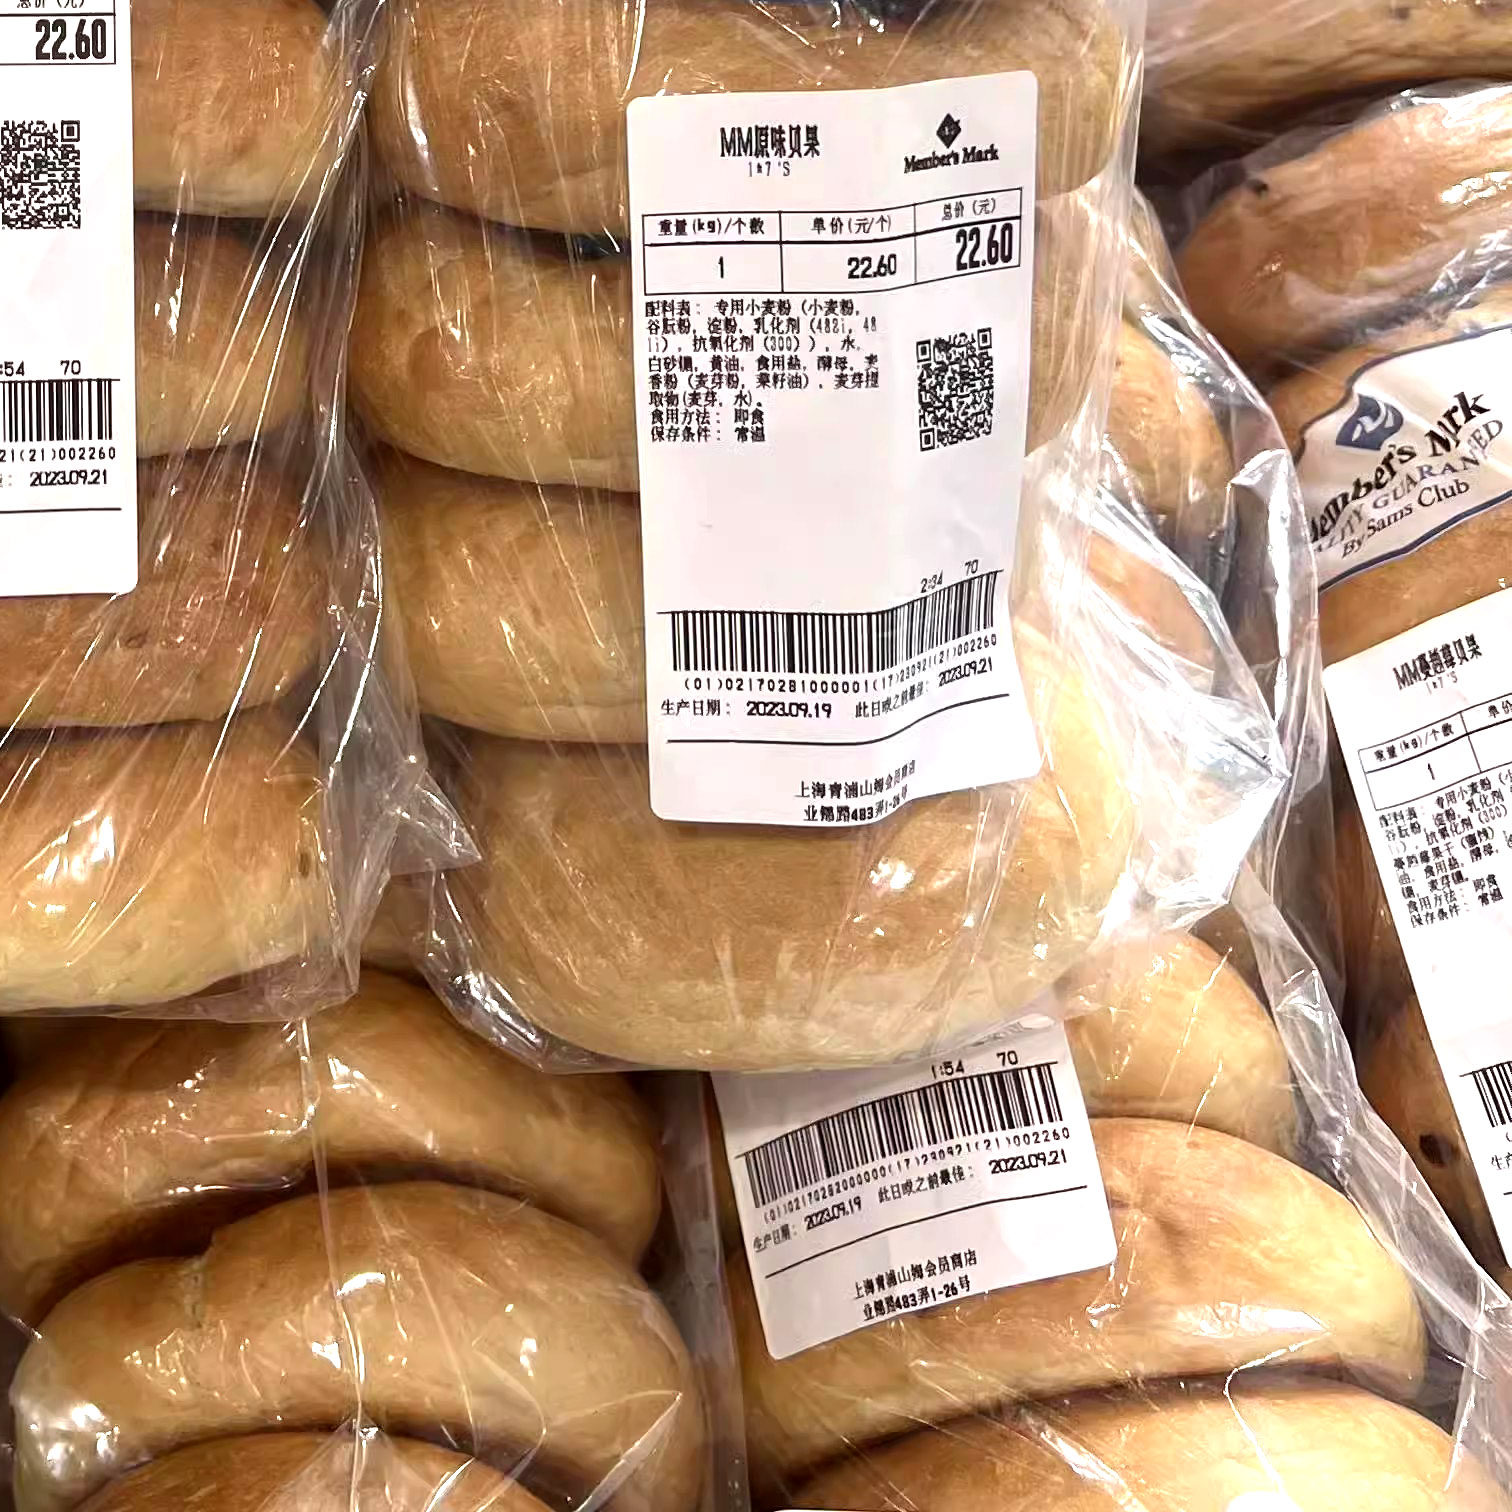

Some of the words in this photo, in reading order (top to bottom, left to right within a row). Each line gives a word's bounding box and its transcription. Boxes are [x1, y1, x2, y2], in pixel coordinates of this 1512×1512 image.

[35, 19, 107, 60] 22.60
[720, 125, 820, 158] MM原味贝果
[955, 222, 1013, 271] 22.60
[718, 256, 725, 278] 1
[847, 254, 897, 280] 22.60
[61, 360, 82, 375] 70
[30, 469, 108, 487] 2023.09.21
[1418, 479, 1470, 507] Club
[965, 560, 979, 575] 70
[746, 701, 832, 719] 2023.09.19
[938, 656, 993, 688] 2023.09.21
[931, 1060, 965, 1079] 1:54
[997, 1050, 1019, 1067] 70
[805, 1196, 862, 1232] 2023.09.19
[988, 1149, 1069, 1175] 2023.09.21
